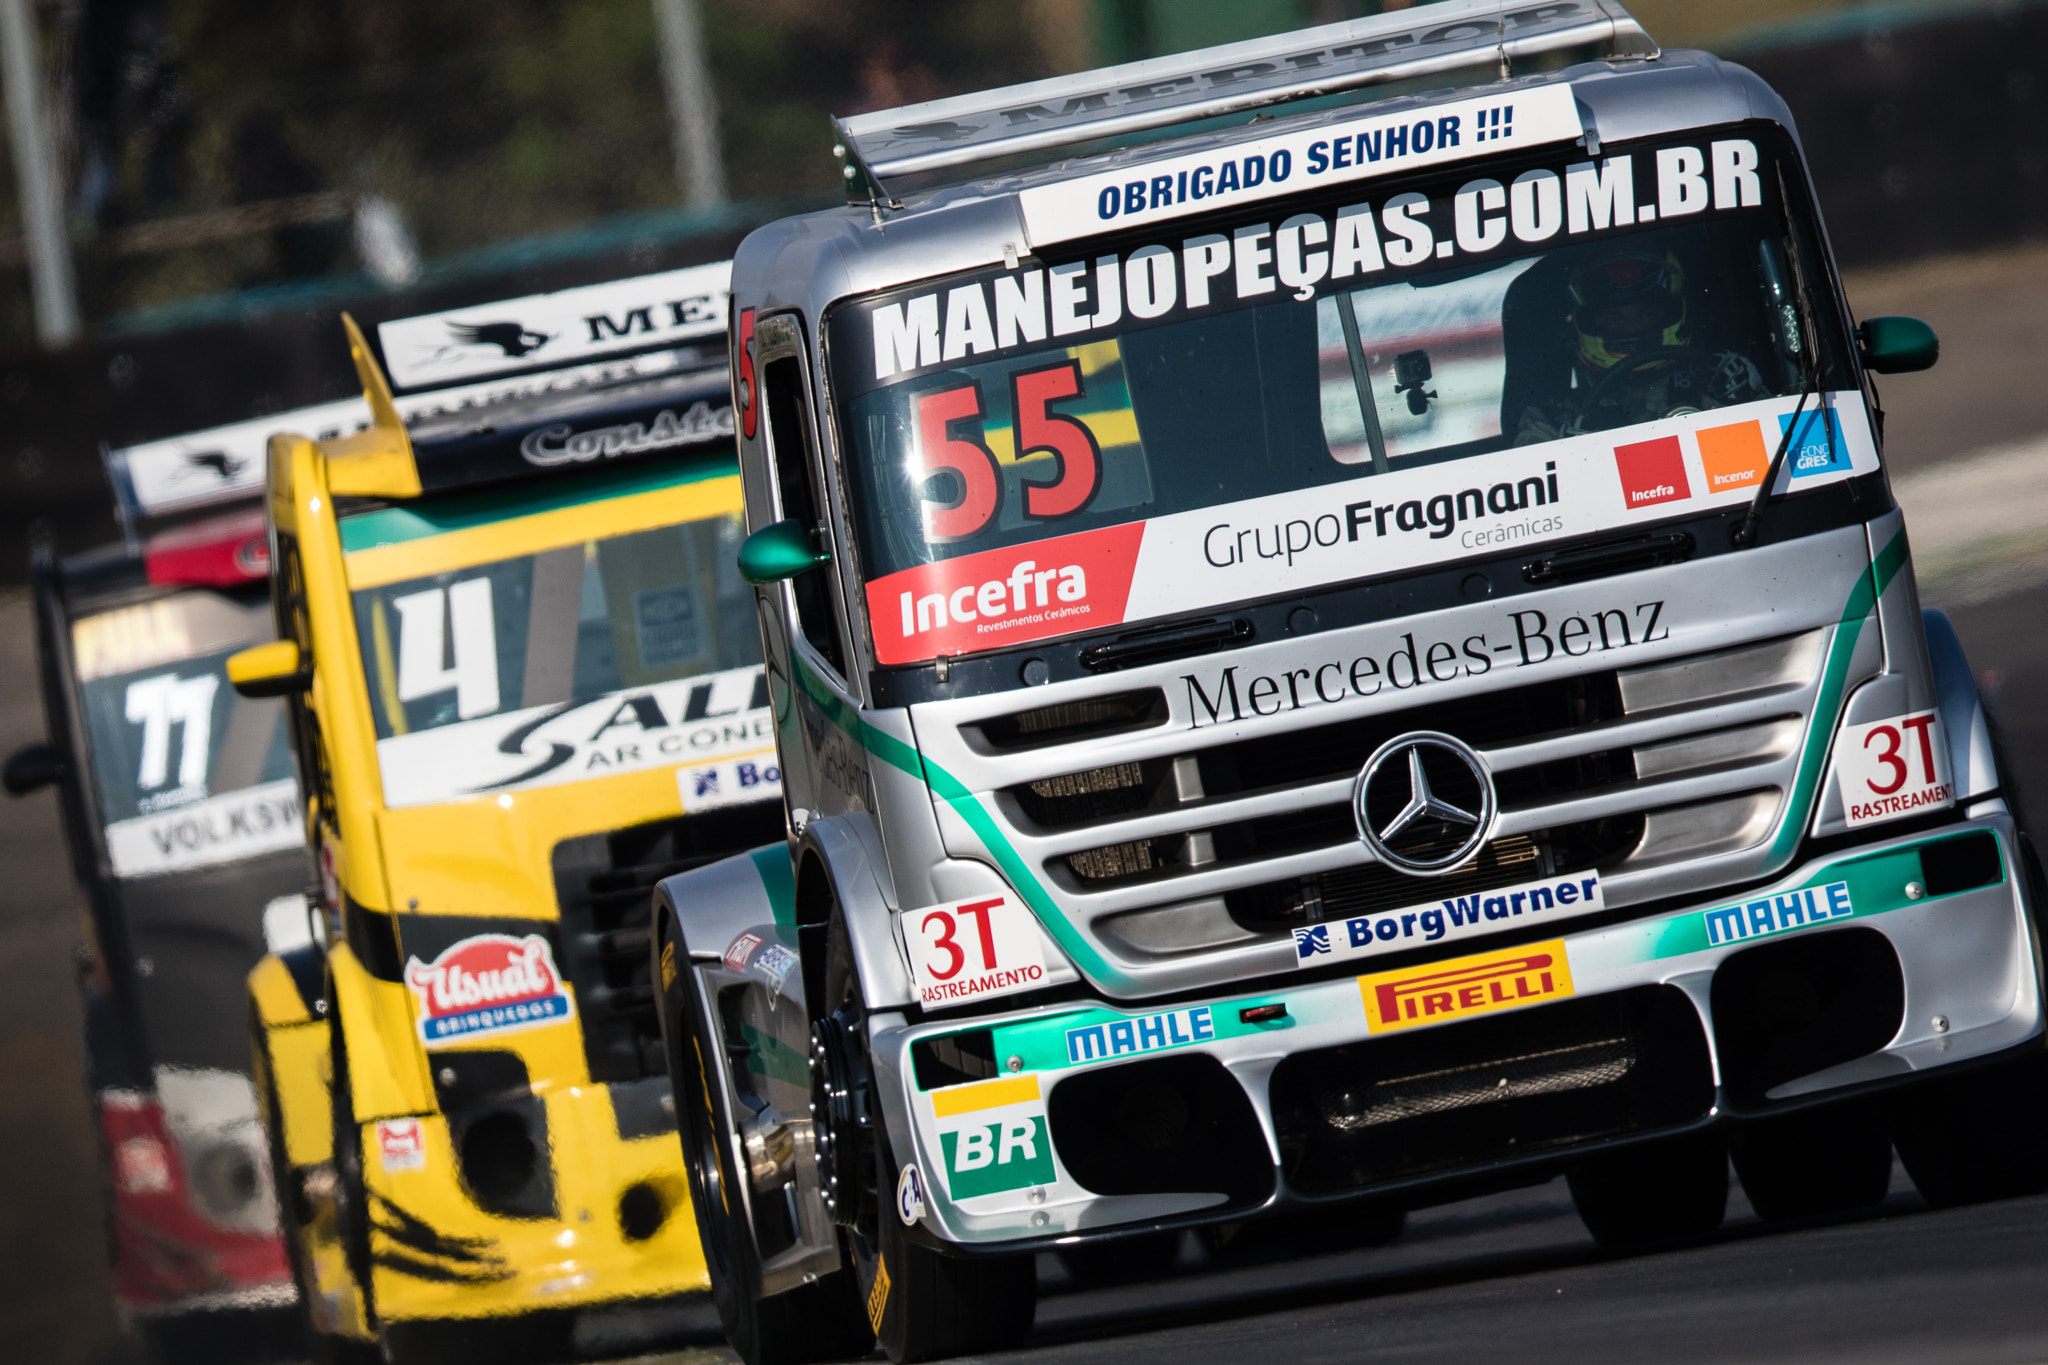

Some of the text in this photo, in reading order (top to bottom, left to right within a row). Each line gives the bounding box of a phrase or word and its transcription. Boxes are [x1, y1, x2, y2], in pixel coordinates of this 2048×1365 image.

[1097, 104, 1515, 221] OBRIGADO SENHOR !!!
[872, 138, 1763, 381] MANEJOPEÇAS.COM.BR
[585, 290, 730, 343] ME
[909, 356, 1104, 546] 55
[1713, 469, 1756, 486] Incenor
[1796, 454, 1829, 470] GRES
[1631, 484, 1675, 502] Incefra
[1460, 515, 1564, 550] Cerâmicas
[900, 560, 1087, 638] Incefra
[976, 604, 1091, 634] Revestimentos Cerâmicas
[393, 576, 500, 720] 4
[1179, 600, 1670, 731] Mercedes-Benz
[124, 672, 221, 790] 11
[586, 743, 641, 770] AR
[1863, 713, 1937, 796] 3T
[921, 896, 1006, 981] 3T
[1349, 877, 1599, 949] BorgWarner
[1707, 882, 1853, 947] MAHLE
[412, 940, 548, 1010] Usual
[921, 964, 1043, 1003] RASTREAMENTO
[1374, 953, 1556, 1026] PIRELLI
[1067, 1006, 1214, 1063] MAHLE
[953, 1116, 1037, 1173] BR
